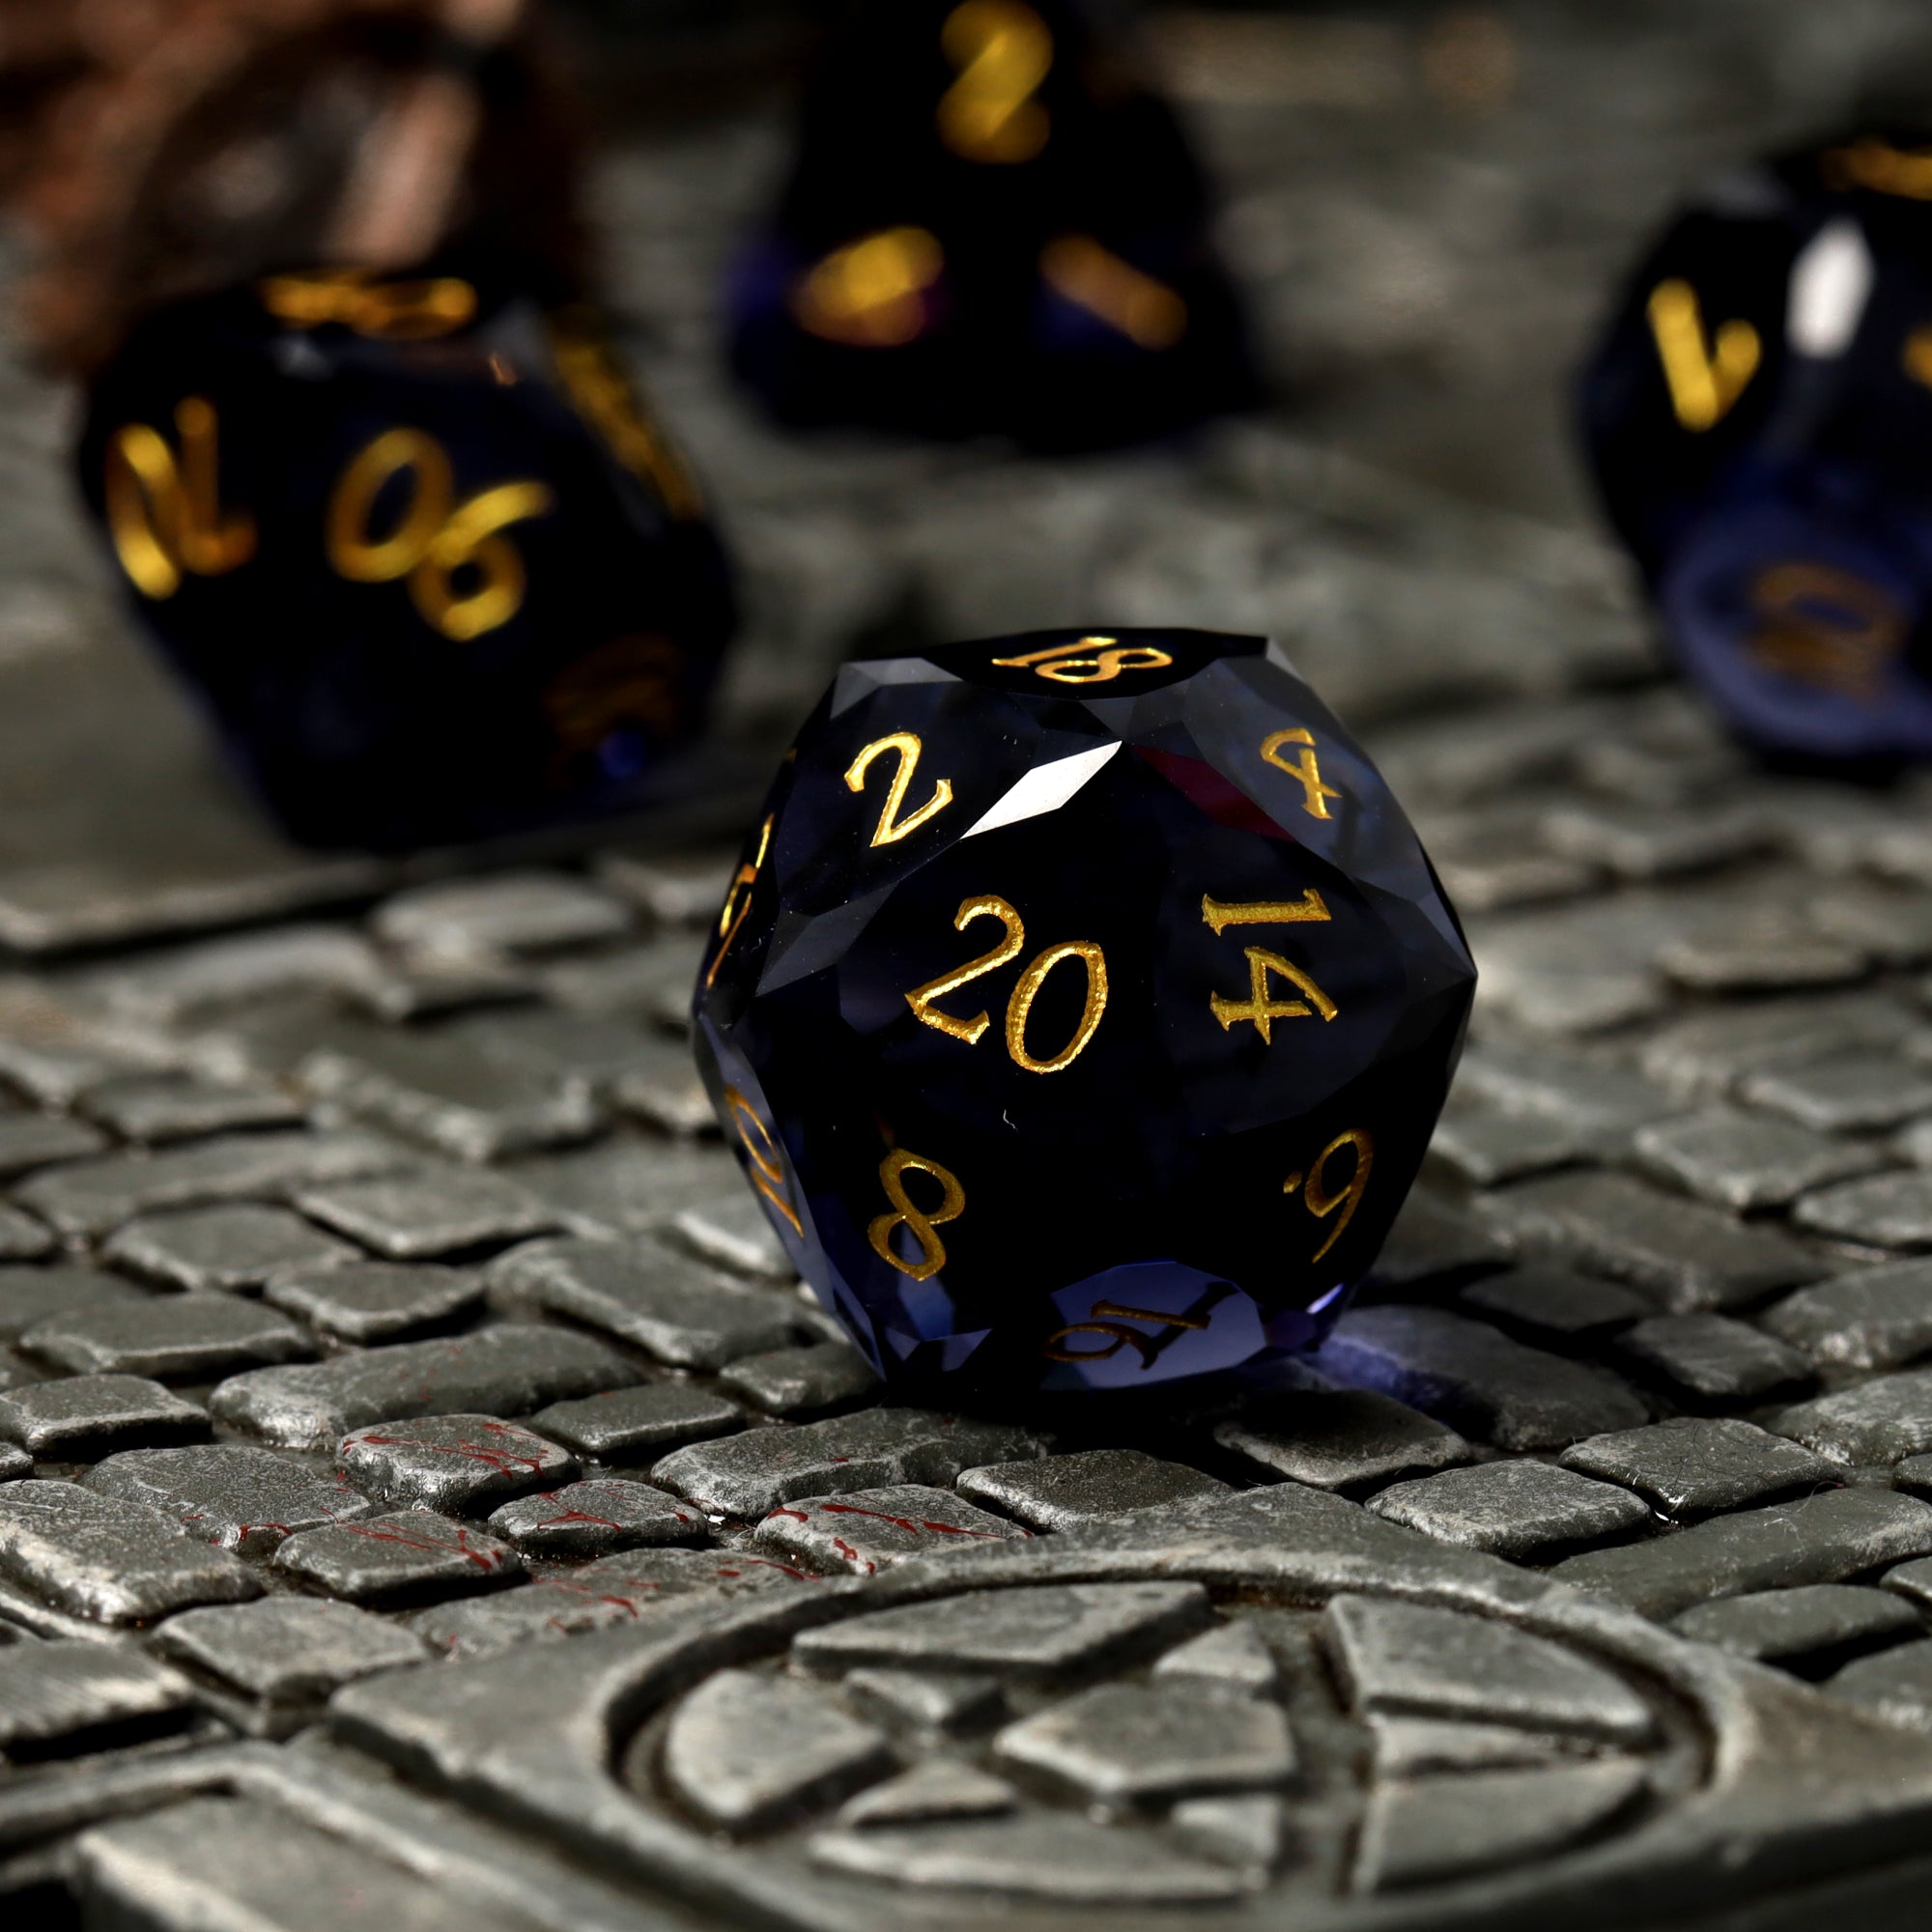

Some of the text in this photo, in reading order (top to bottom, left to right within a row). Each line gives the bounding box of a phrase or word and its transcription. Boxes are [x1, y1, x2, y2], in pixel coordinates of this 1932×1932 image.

[991, 636, 1173, 684] 18
[843, 731, 953, 847] 2
[1260, 726, 1341, 820] 4
[904, 895, 1109, 1075] 20
[1202, 889, 1339, 1045] 14
[867, 1149, 966, 1282] 8
